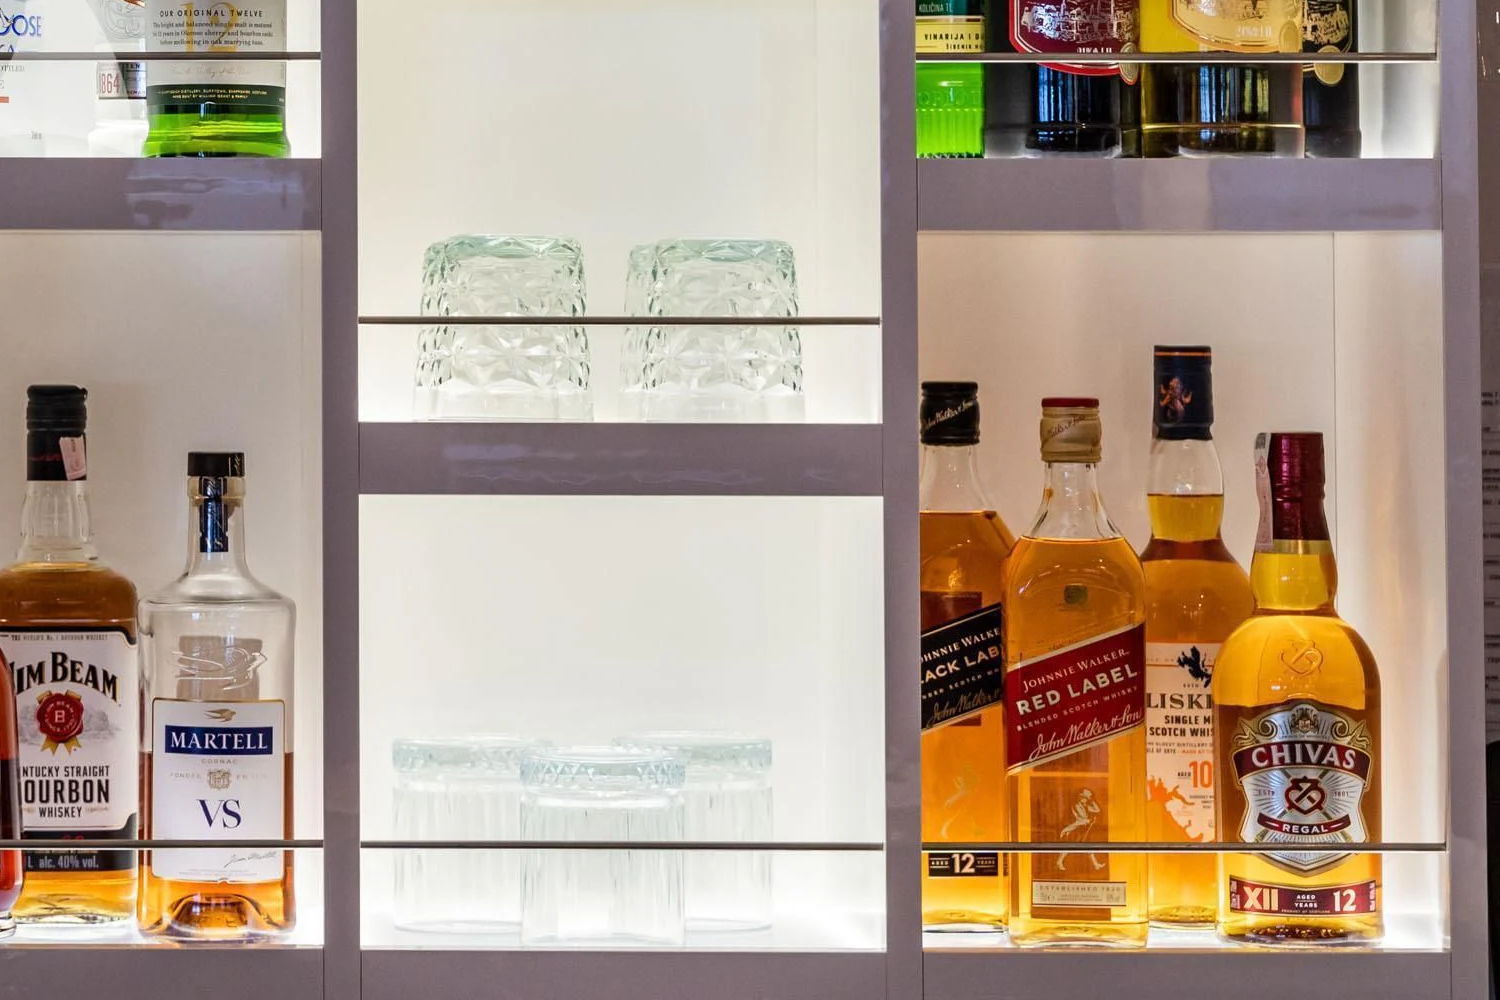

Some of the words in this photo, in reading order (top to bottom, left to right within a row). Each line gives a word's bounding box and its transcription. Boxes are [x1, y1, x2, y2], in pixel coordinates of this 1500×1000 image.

[177, 9, 225, 17] ORIGINAL
[230, 9, 263, 17] TWELVE
[961, 627, 1000, 648] WALKE
[921, 641, 961, 663] OHNNIE
[963, 645, 1001, 667] LAB
[50, 651, 119, 703] BEAM
[921, 659, 961, 684] ACK
[1023, 665, 1076, 693] JOHNNIE
[1076, 648, 1126, 671] WALKER
[1016, 689, 1061, 716] RED
[1067, 663, 1138, 698] LABEL
[1016, 713, 1058, 732] BLENDED
[1062, 700, 1099, 716] SCOTCH
[1103, 686, 1138, 702] WHISKY
[1164, 715, 1200, 725] SINGLE
[171, 731, 268, 750] MARTELL
[1028, 732, 1066, 762] John
[1064, 717, 1109, 745] Walker
[1149, 726, 1186, 737] SCOTCH
[1251, 743, 1356, 769] CHIVAS
[22, 765, 60, 777] NTUCKY
[64, 765, 110, 777] STRAIGHT
[1188, 760, 1212, 788] 10
[24, 779, 110, 803] OURBON
[39, 806, 82, 818] WHISKEY
[196, 799, 242, 829] VS
[1282, 824, 1328, 834] REGAL
[57, 856, 80, 869] 40%
[82, 856, 99, 868] vol.
[951, 853, 976, 874] 12
[1243, 886, 1279, 911] XII
[1333, 889, 1357, 912] 12
